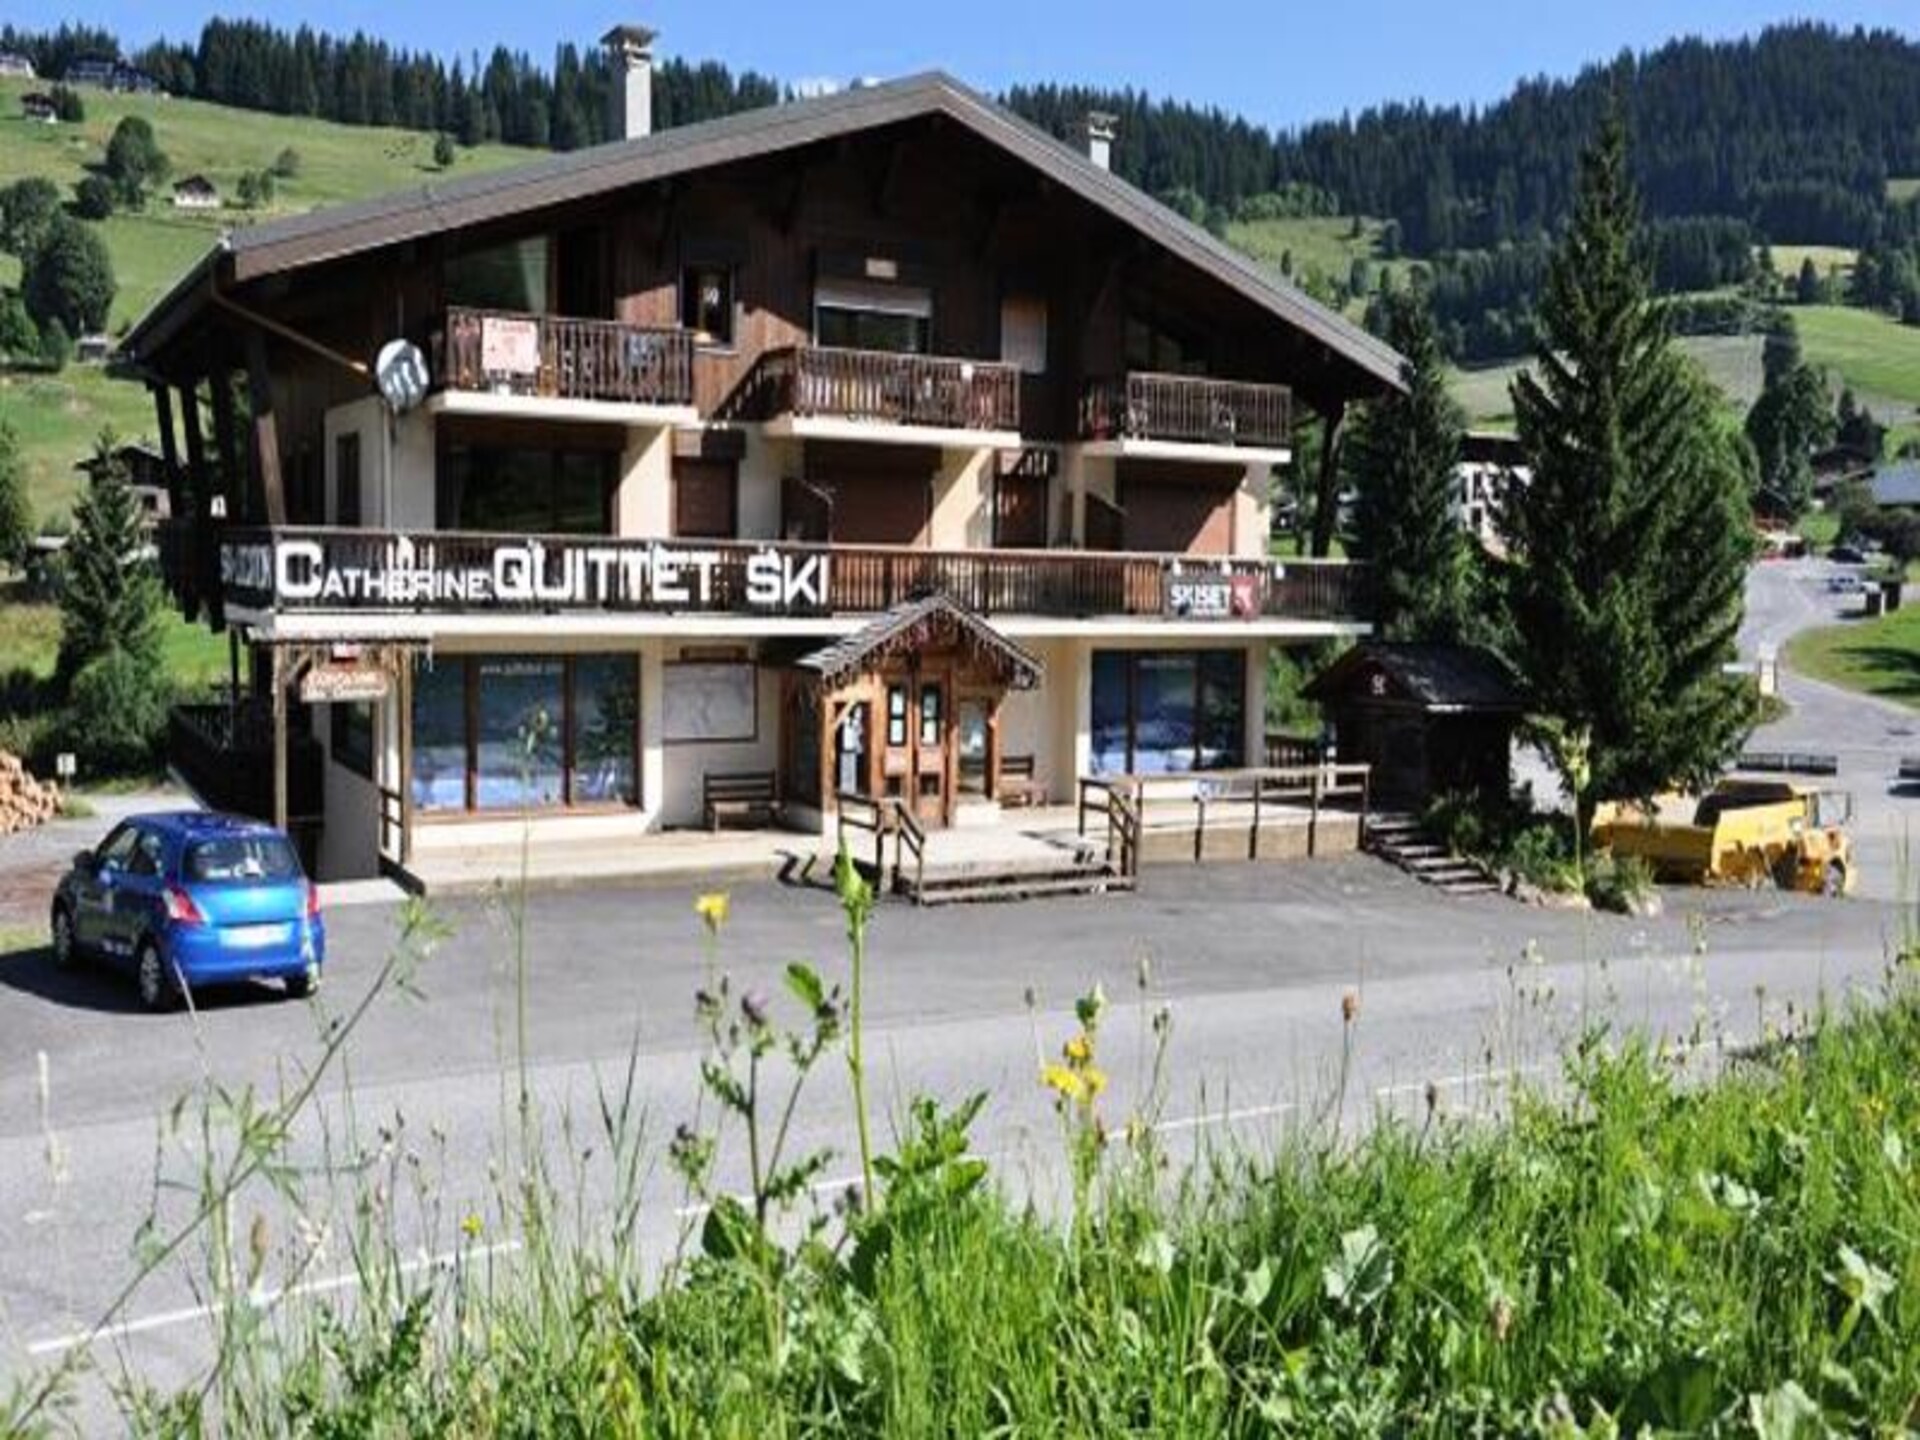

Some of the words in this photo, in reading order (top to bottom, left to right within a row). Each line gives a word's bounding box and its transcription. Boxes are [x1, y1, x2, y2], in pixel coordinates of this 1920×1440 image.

[494, 546, 719, 601] QUITTET
[745, 549, 829, 604] SKI
[1170, 584, 1231, 609] SKISET
